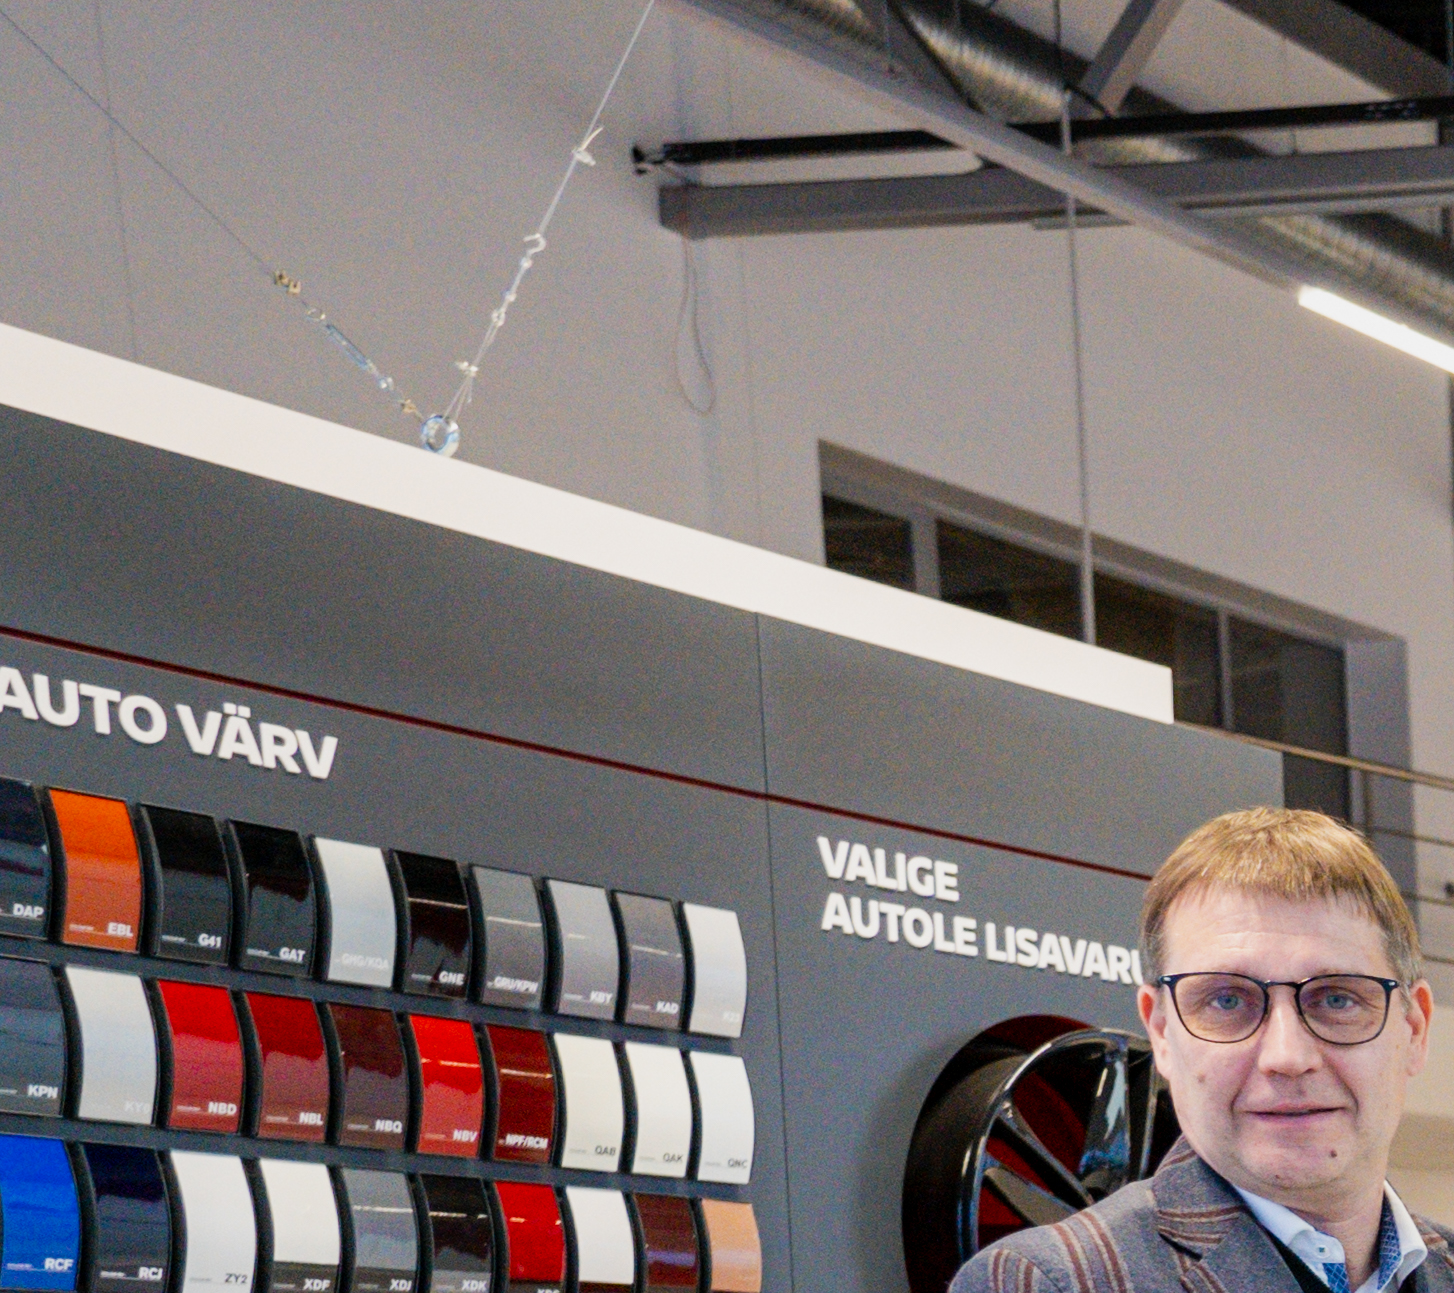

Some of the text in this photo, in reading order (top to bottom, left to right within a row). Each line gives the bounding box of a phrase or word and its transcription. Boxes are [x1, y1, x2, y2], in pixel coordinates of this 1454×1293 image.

[0, 666, 338, 779] AUTO VÄRV
[817, 836, 960, 902] VALIGE
[12, 903, 44, 918] DAP
[106, 921, 134, 938] EBL
[821, 892, 978, 957] AUTOLE
[198, 933, 222, 948] G41
[279, 947, 306, 963] GAT
[656, 1001, 679, 1015] KAD
[27, 1084, 59, 1099] KPN
[208, 1101, 238, 1116] NBD
[299, 1112, 324, 1126] NBL
[375, 1119, 403, 1133] NBQ
[453, 1129, 478, 1142] NBV
[594, 1145, 617, 1157] QAB
[662, 1152, 683, 1164] QAK
[727, 1158, 748, 1170] QNC
[44, 1257, 74, 1271] RCF
[224, 1273, 248, 1285] ZY2
[303, 1278, 331, 1291] XDF
[389, 1278, 413, 1291] XDJ
[461, 1279, 487, 1291] XDK
